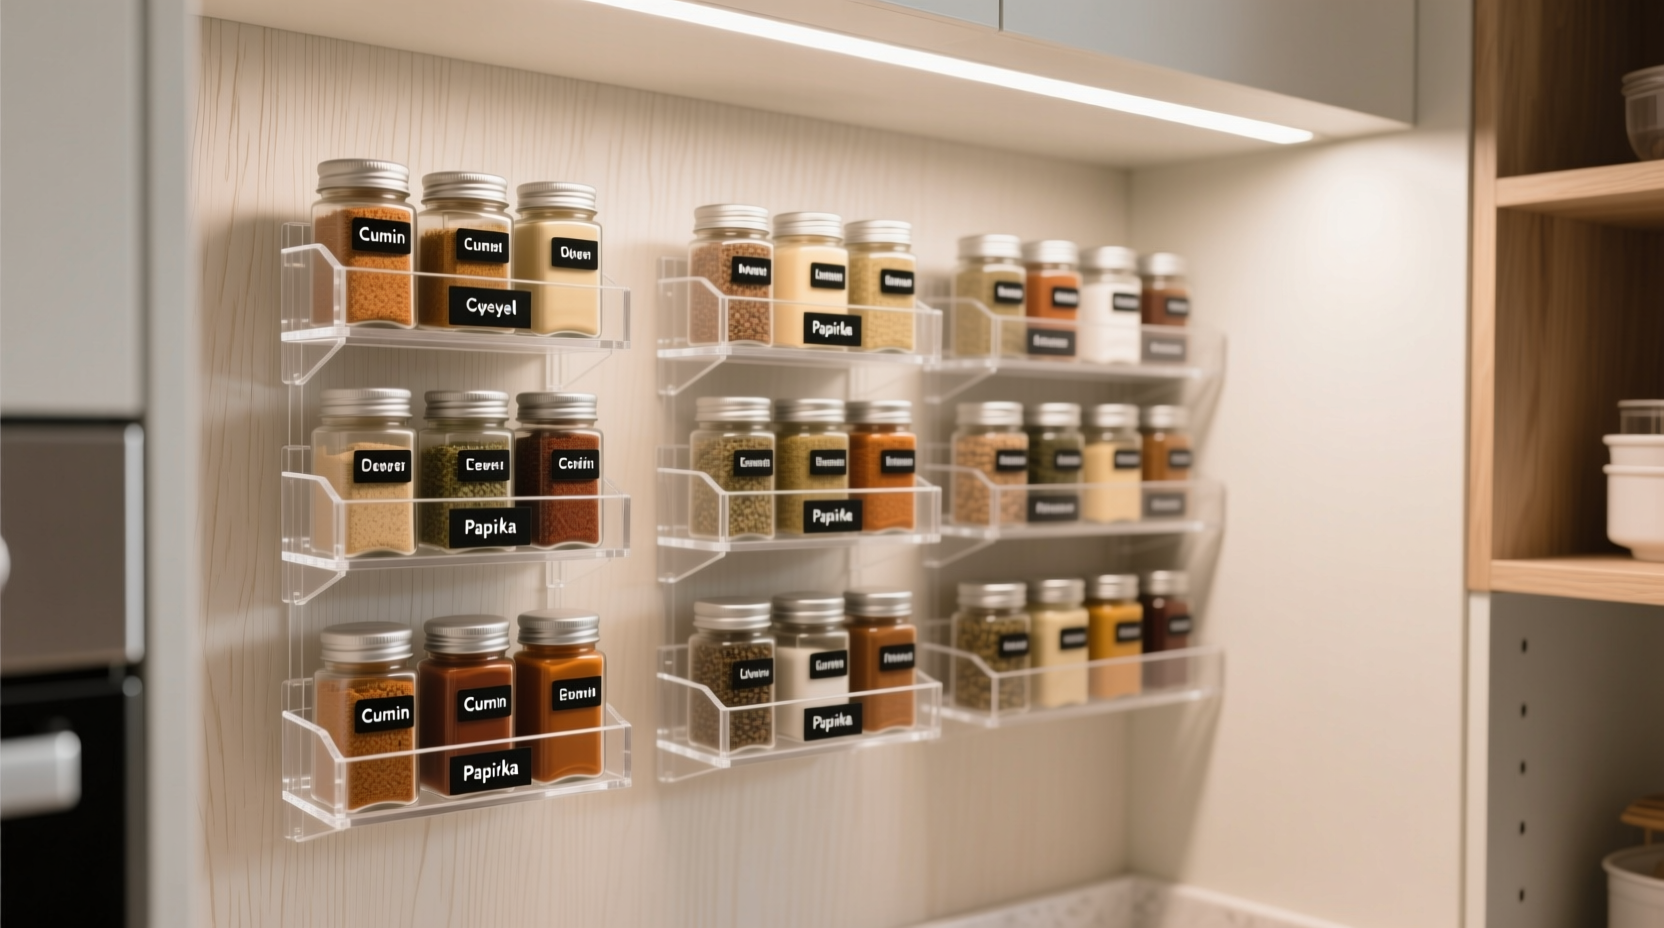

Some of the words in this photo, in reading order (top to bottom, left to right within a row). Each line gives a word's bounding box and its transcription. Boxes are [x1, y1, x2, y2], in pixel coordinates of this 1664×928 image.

[359, 227, 405, 244] Cumin
[465, 517, 516, 538] Papika
[464, 697, 506, 711] Cumin
[362, 706, 409, 723] Cumin
